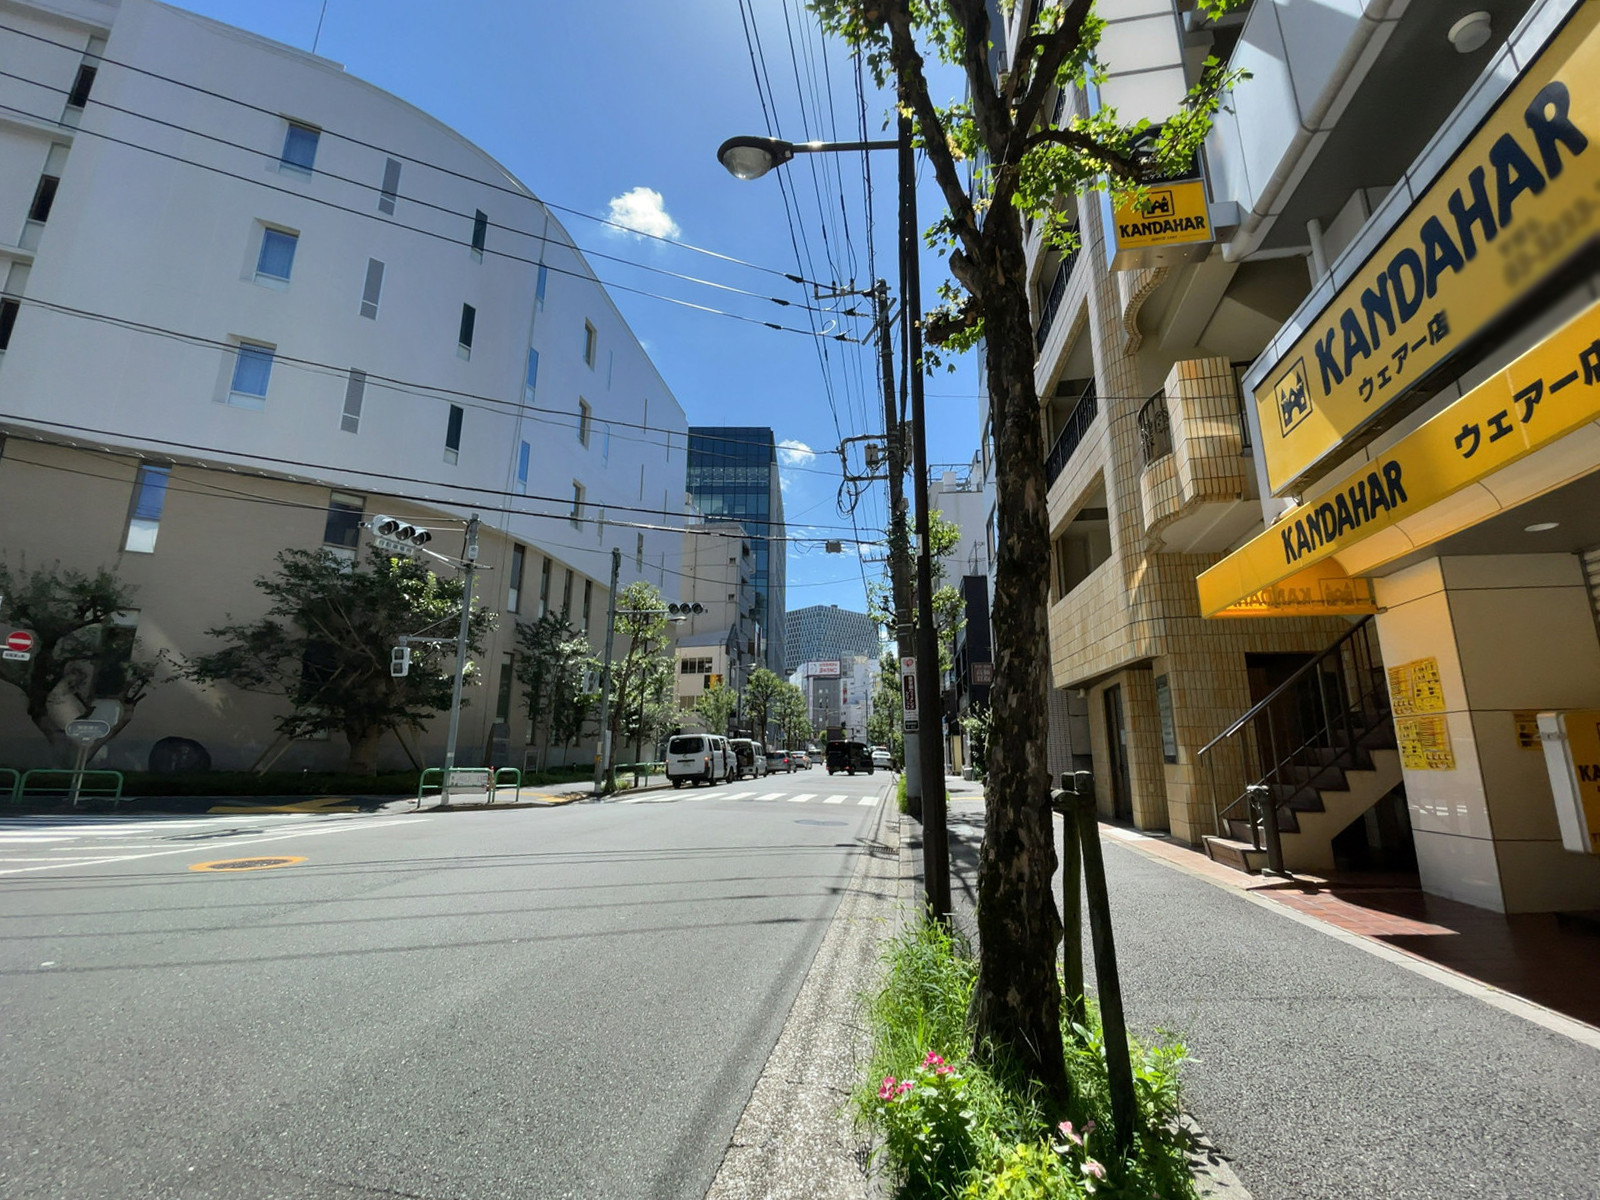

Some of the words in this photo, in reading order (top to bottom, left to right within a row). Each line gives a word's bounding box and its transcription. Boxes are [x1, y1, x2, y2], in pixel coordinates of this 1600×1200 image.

[1119, 215, 1206, 238] KANDAHAR
[1314, 80, 1588, 396] KANDAHAR
[1358, 309, 1449, 403] ウェアー店
[1281, 460, 1408, 565] KANDAHAR
